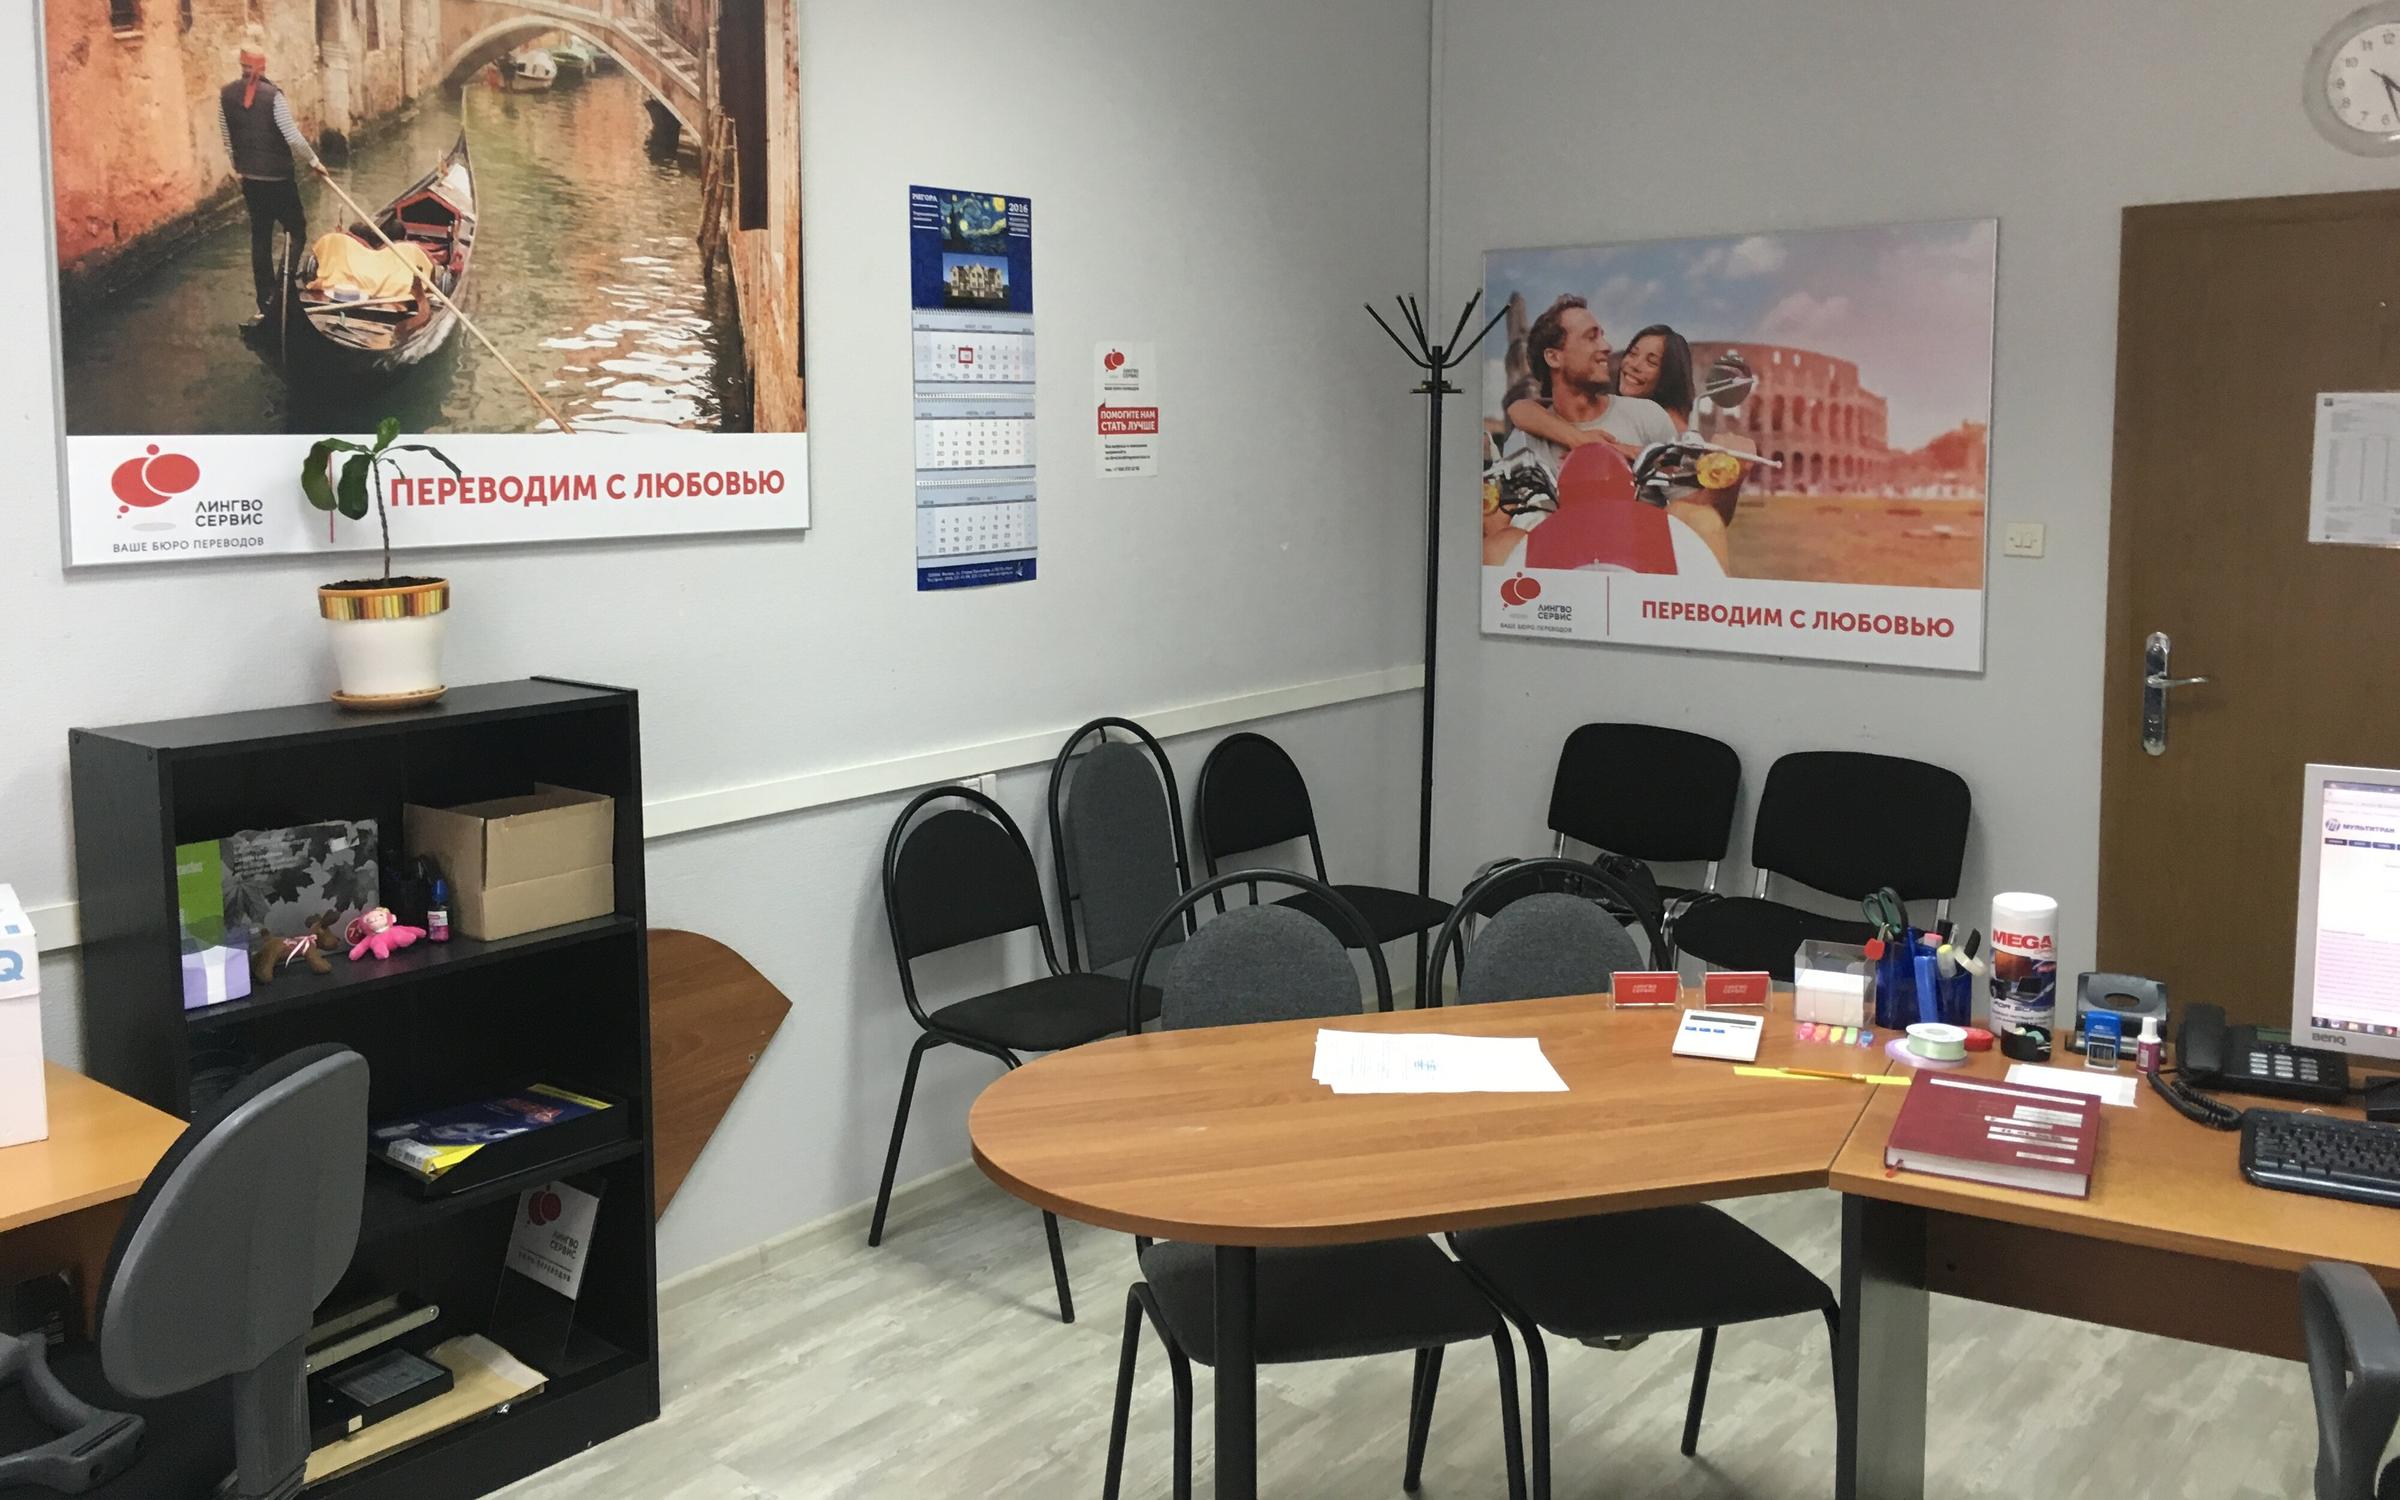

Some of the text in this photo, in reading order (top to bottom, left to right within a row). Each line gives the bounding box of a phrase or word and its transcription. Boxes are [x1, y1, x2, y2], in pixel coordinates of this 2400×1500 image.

[1008, 203, 1028, 213] 2016
[1100, 410, 1156, 419] ПОМОГИТЕ НАМ
[1101, 421, 1155, 431] СТАТЬ ЛУЧШЕ
[390, 469, 785, 507] ПЕРЕВОДИМ С ЛЮБОВЬЮ
[195, 499, 263, 513] ЛИНГВО
[195, 513, 263, 527] СЕРВИС
[113, 536, 264, 553] ВАШЕ БЮРО ПЕРЕВОДОВ
[1537, 604, 1572, 613] ЛИНГВО
[1537, 612, 1572, 621] СЕРВИС
[1641, 600, 1955, 638] ПЕРЕВОДИМ С ЛЮБОВЬЮ
[1992, 930, 2052, 949] MEGA
[549, 1240, 577, 1259] СЕРВИС
